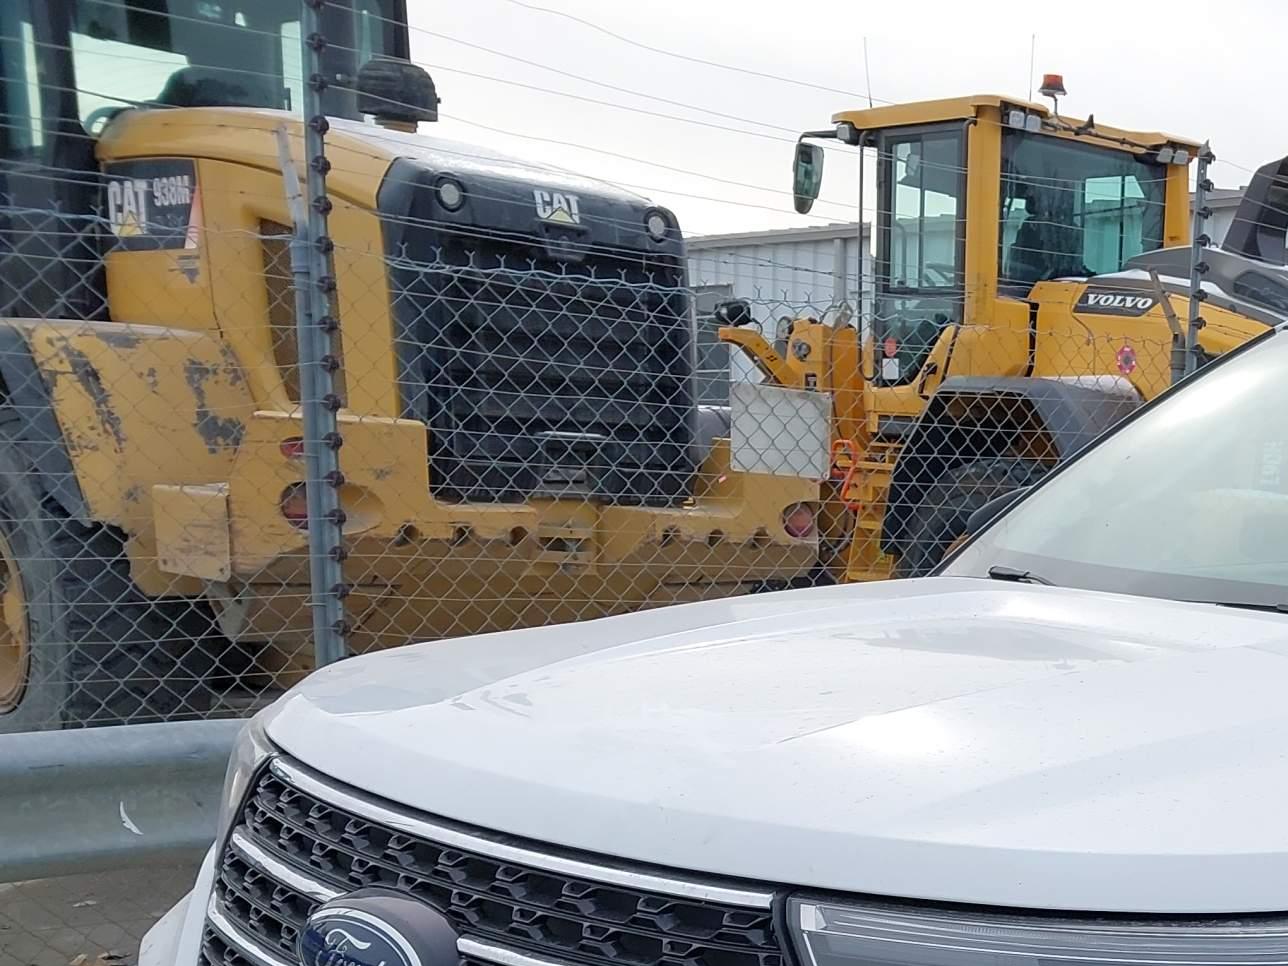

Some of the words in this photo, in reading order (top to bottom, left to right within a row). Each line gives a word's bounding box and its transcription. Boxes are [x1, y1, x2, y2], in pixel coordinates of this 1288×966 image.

[108, 181, 147, 235] CAT
[153, 175, 190, 207] 938M
[533, 189, 581, 225] CAT
[1087, 293, 1153, 309] VOLVO
